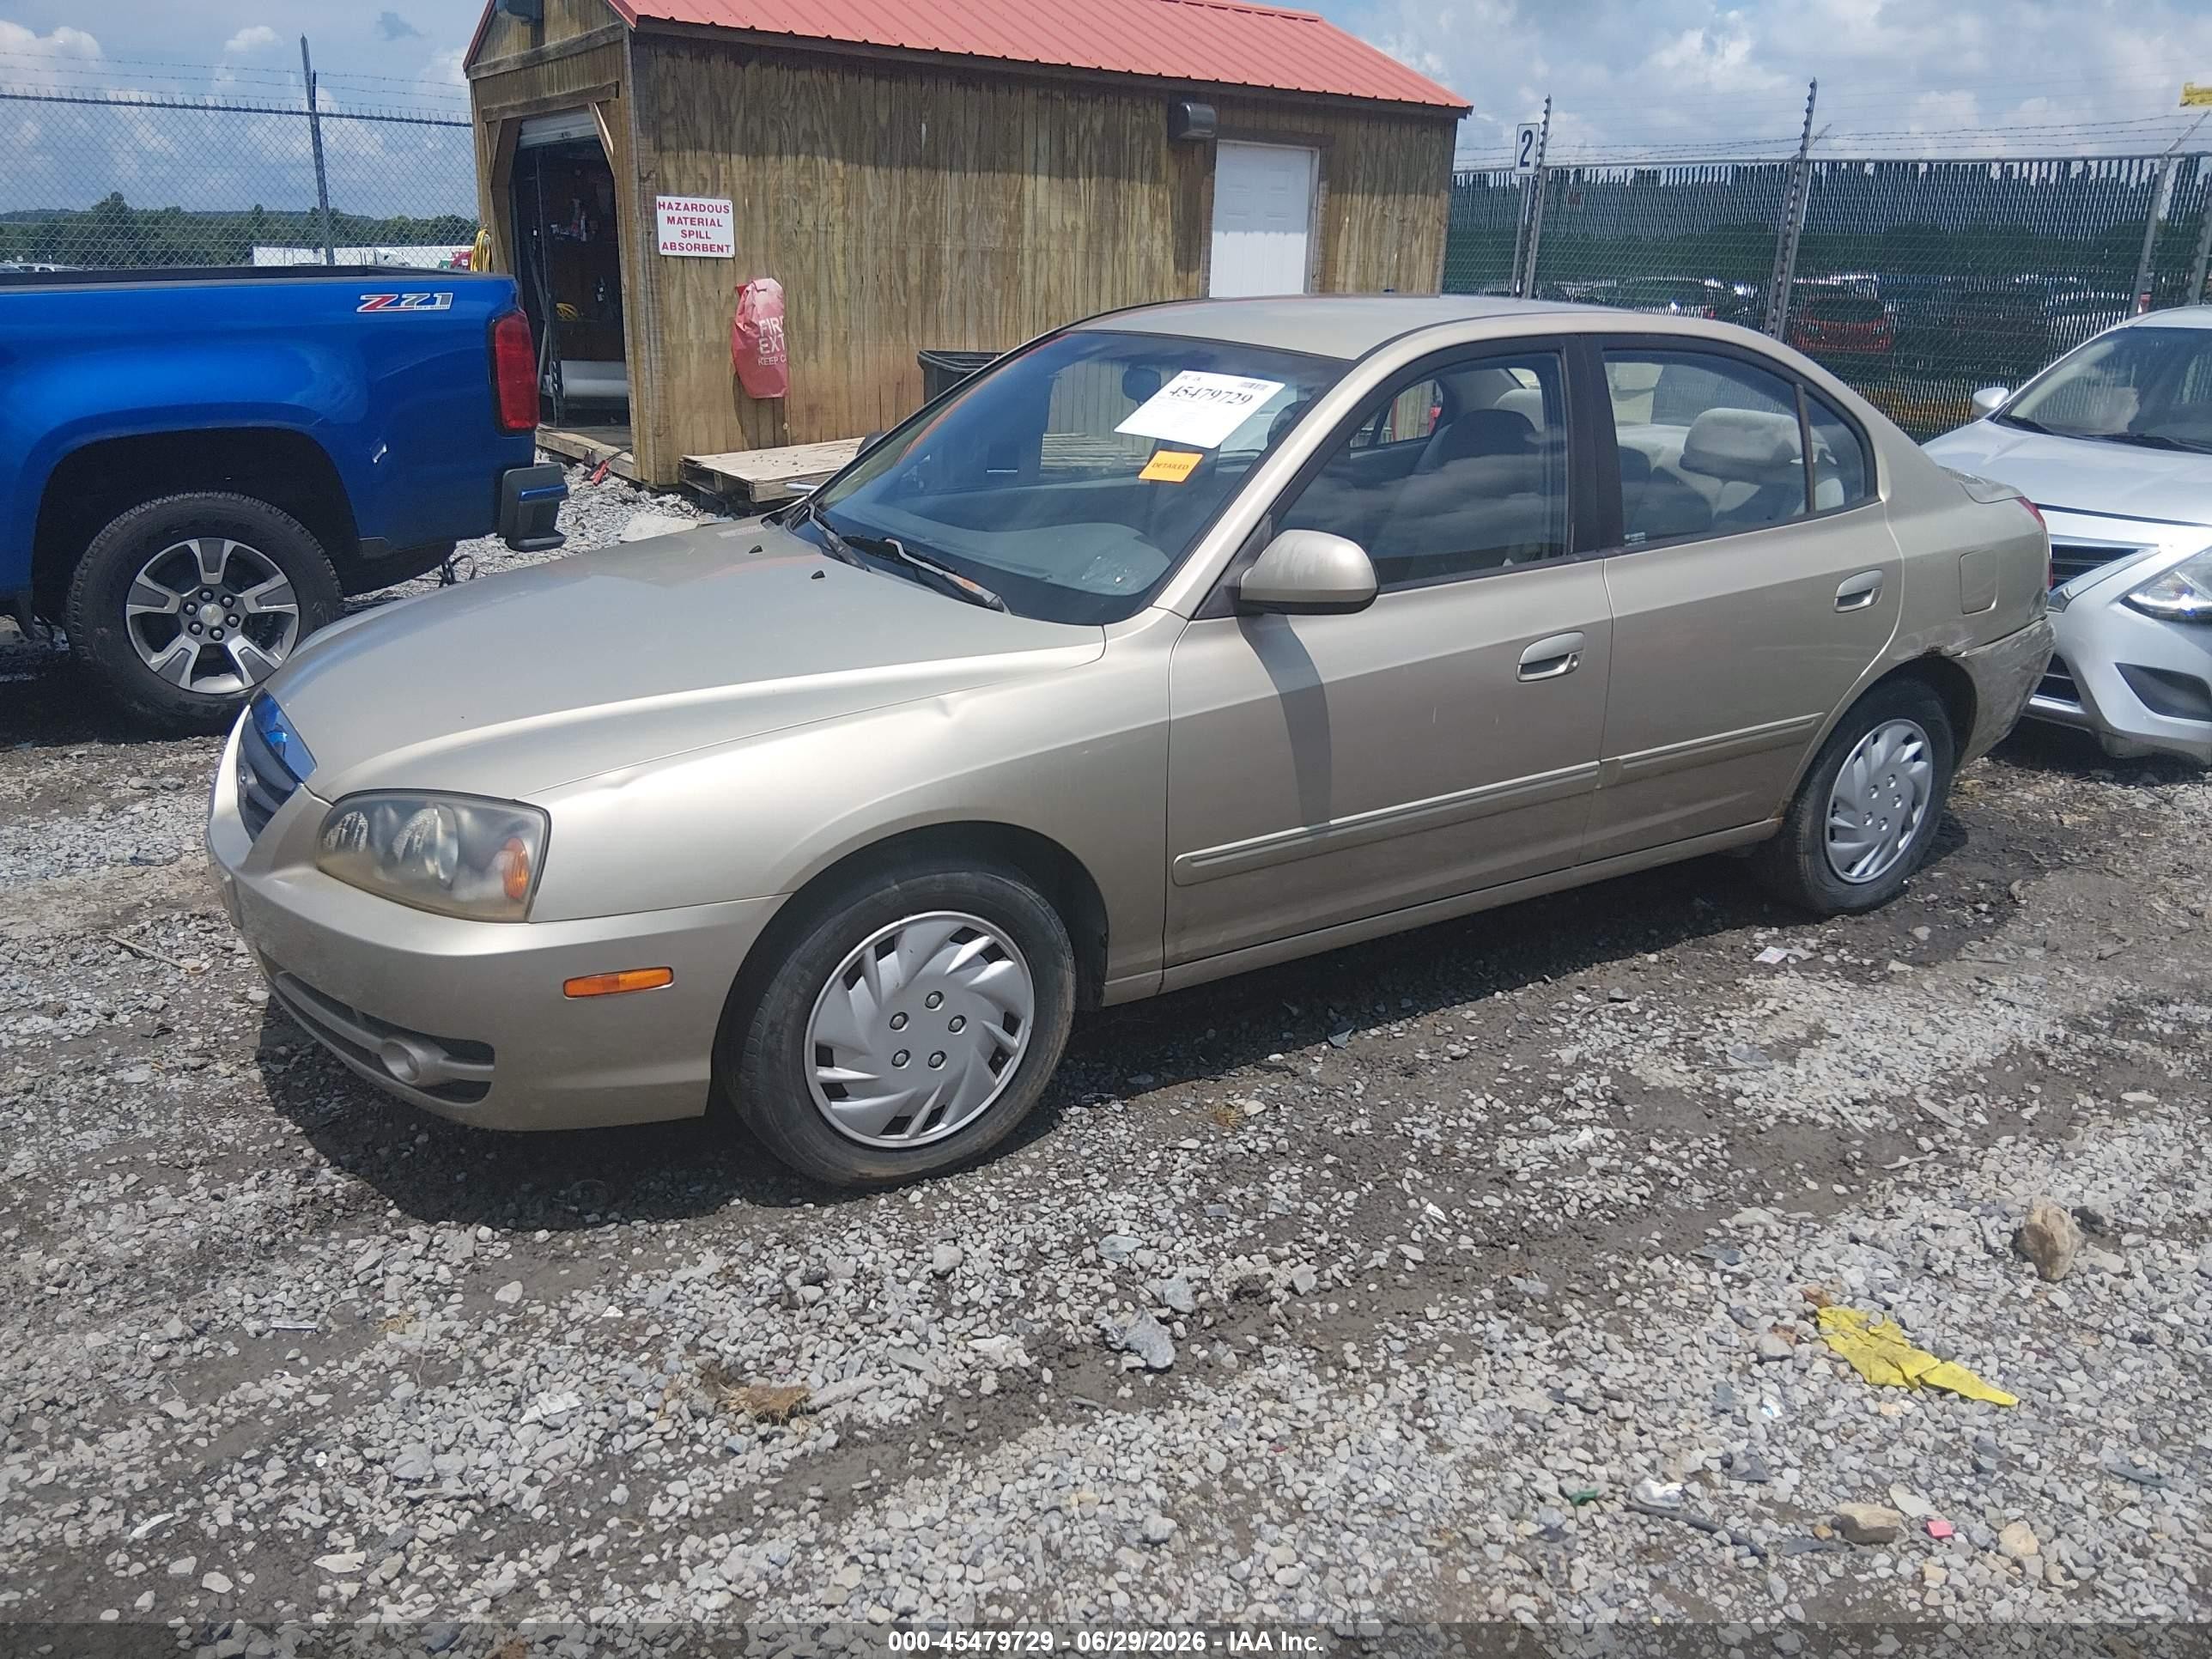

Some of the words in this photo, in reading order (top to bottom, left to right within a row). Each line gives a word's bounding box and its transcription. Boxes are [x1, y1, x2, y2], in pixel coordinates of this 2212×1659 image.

[1519, 130, 1534, 167] 2
[658, 201, 730, 214] HAZARDOUS
[666, 216, 723, 228] MATERIAL
[680, 229, 711, 240] SPILL
[661, 241, 732, 253] ABSORBENT
[356, 293, 453, 313] Z71
[757, 357, 779, 366] KEEP
[1169, 386, 1255, 405] 45479729
[1152, 462, 1190, 471] DETAILED
